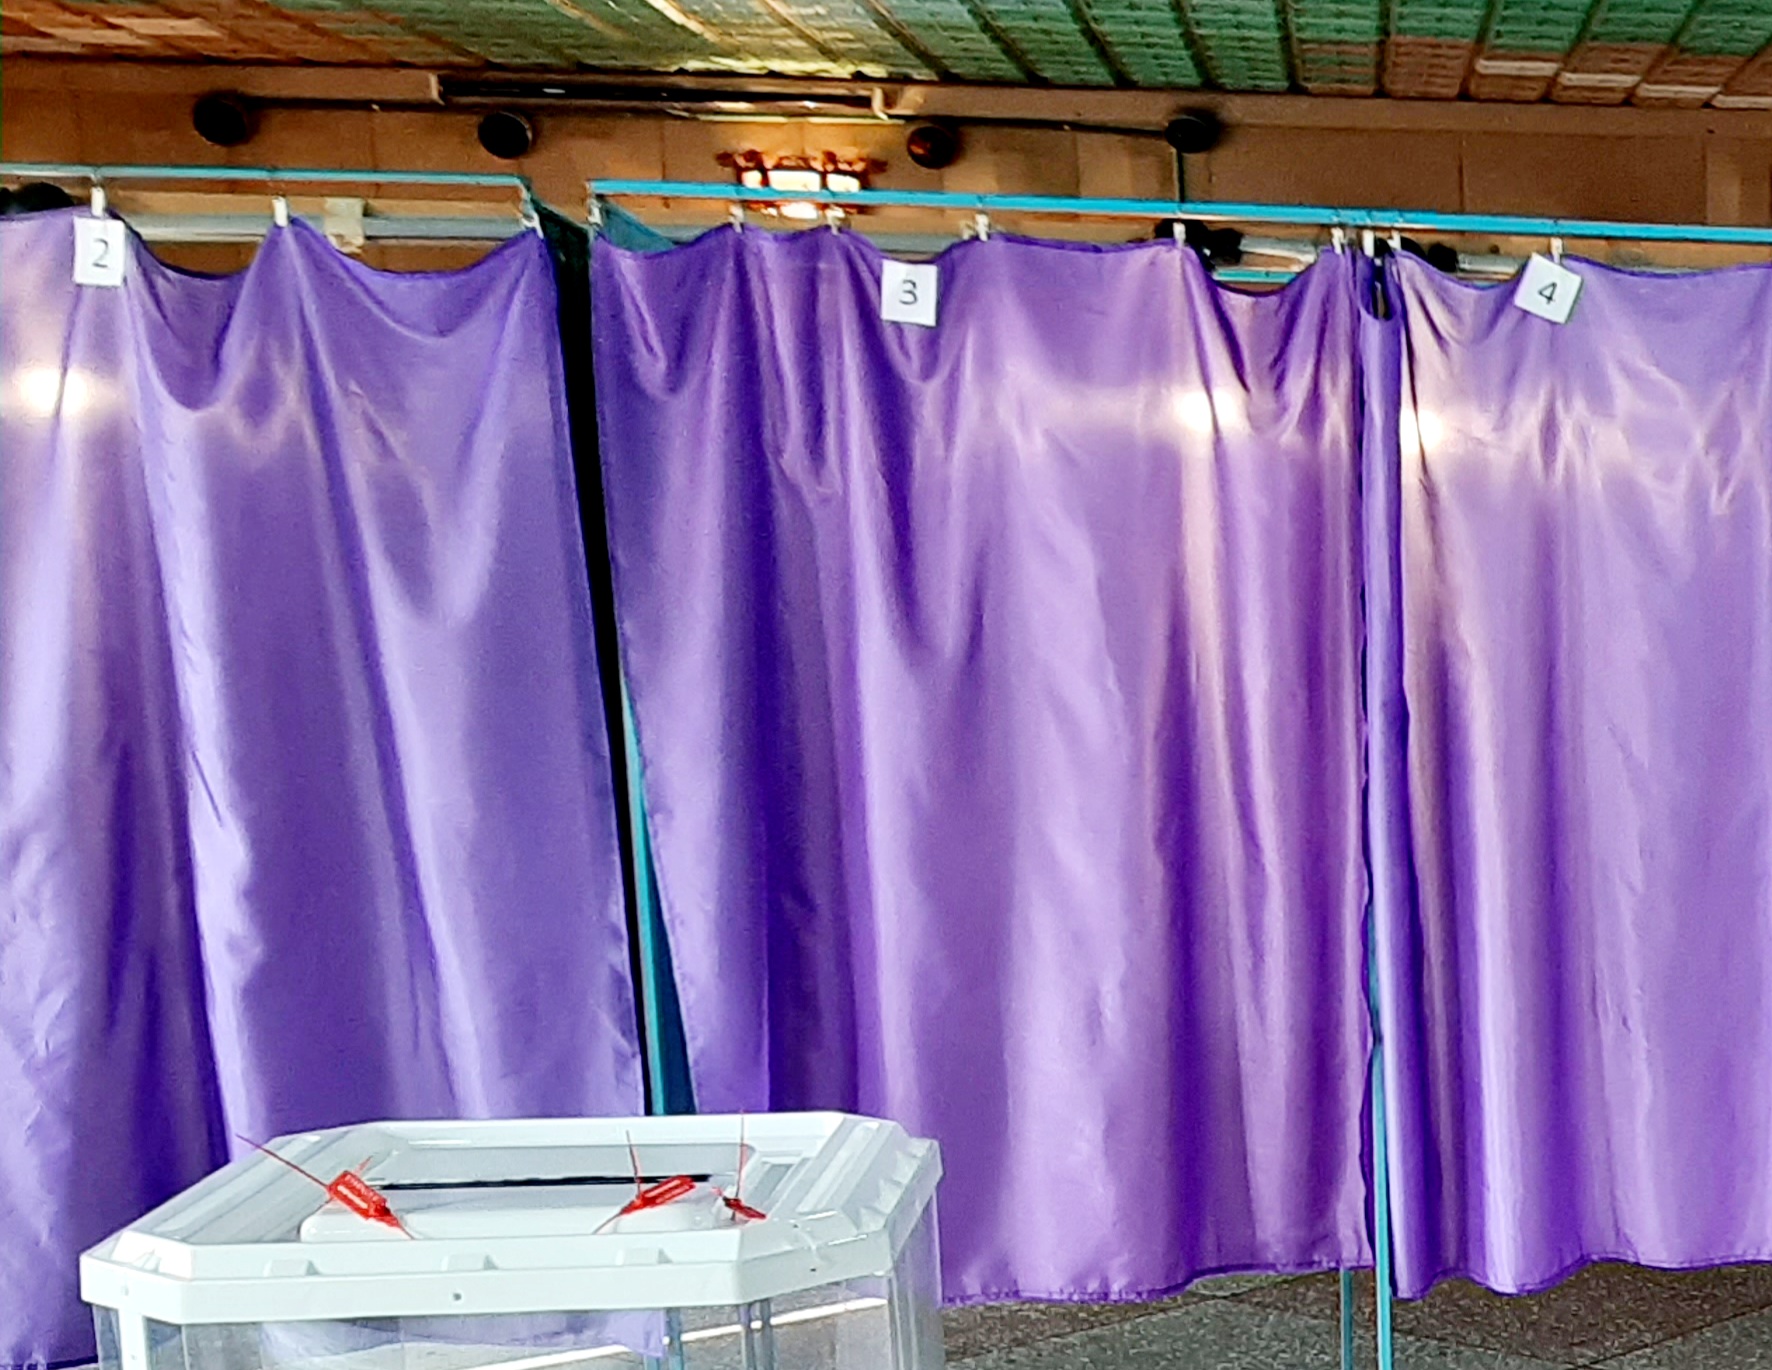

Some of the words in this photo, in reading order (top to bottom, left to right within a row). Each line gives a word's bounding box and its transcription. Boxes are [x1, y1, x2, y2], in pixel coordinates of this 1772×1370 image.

[92, 238, 110, 269] 2
[899, 279, 918, 306] 3
[1537, 281, 1558, 306] 4
